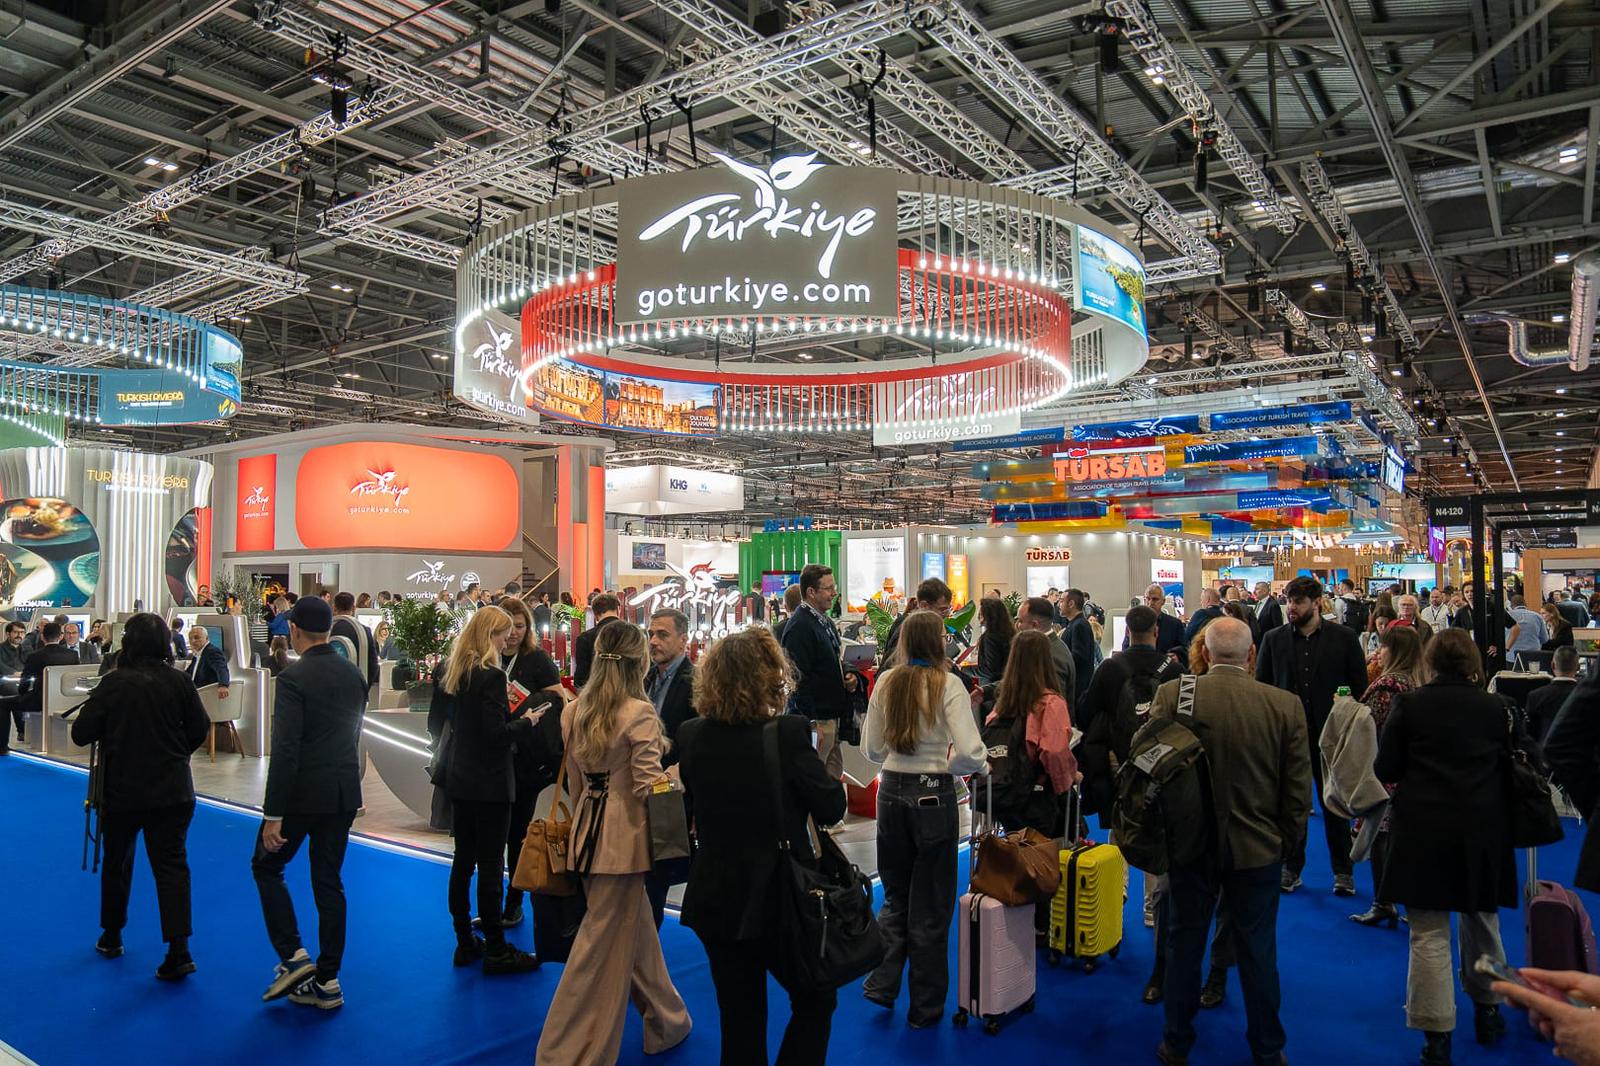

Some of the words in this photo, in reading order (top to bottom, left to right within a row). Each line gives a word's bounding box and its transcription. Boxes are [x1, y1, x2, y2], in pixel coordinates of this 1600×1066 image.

[638, 193, 876, 279] Türkiye
[638, 277, 870, 316] goturkiye.com
[895, 424, 992, 444] goturkiye.com
[350, 481, 410, 506] Türkiye
[669, 478, 688, 490] KHG
[1435, 507, 1463, 516] N4-120
